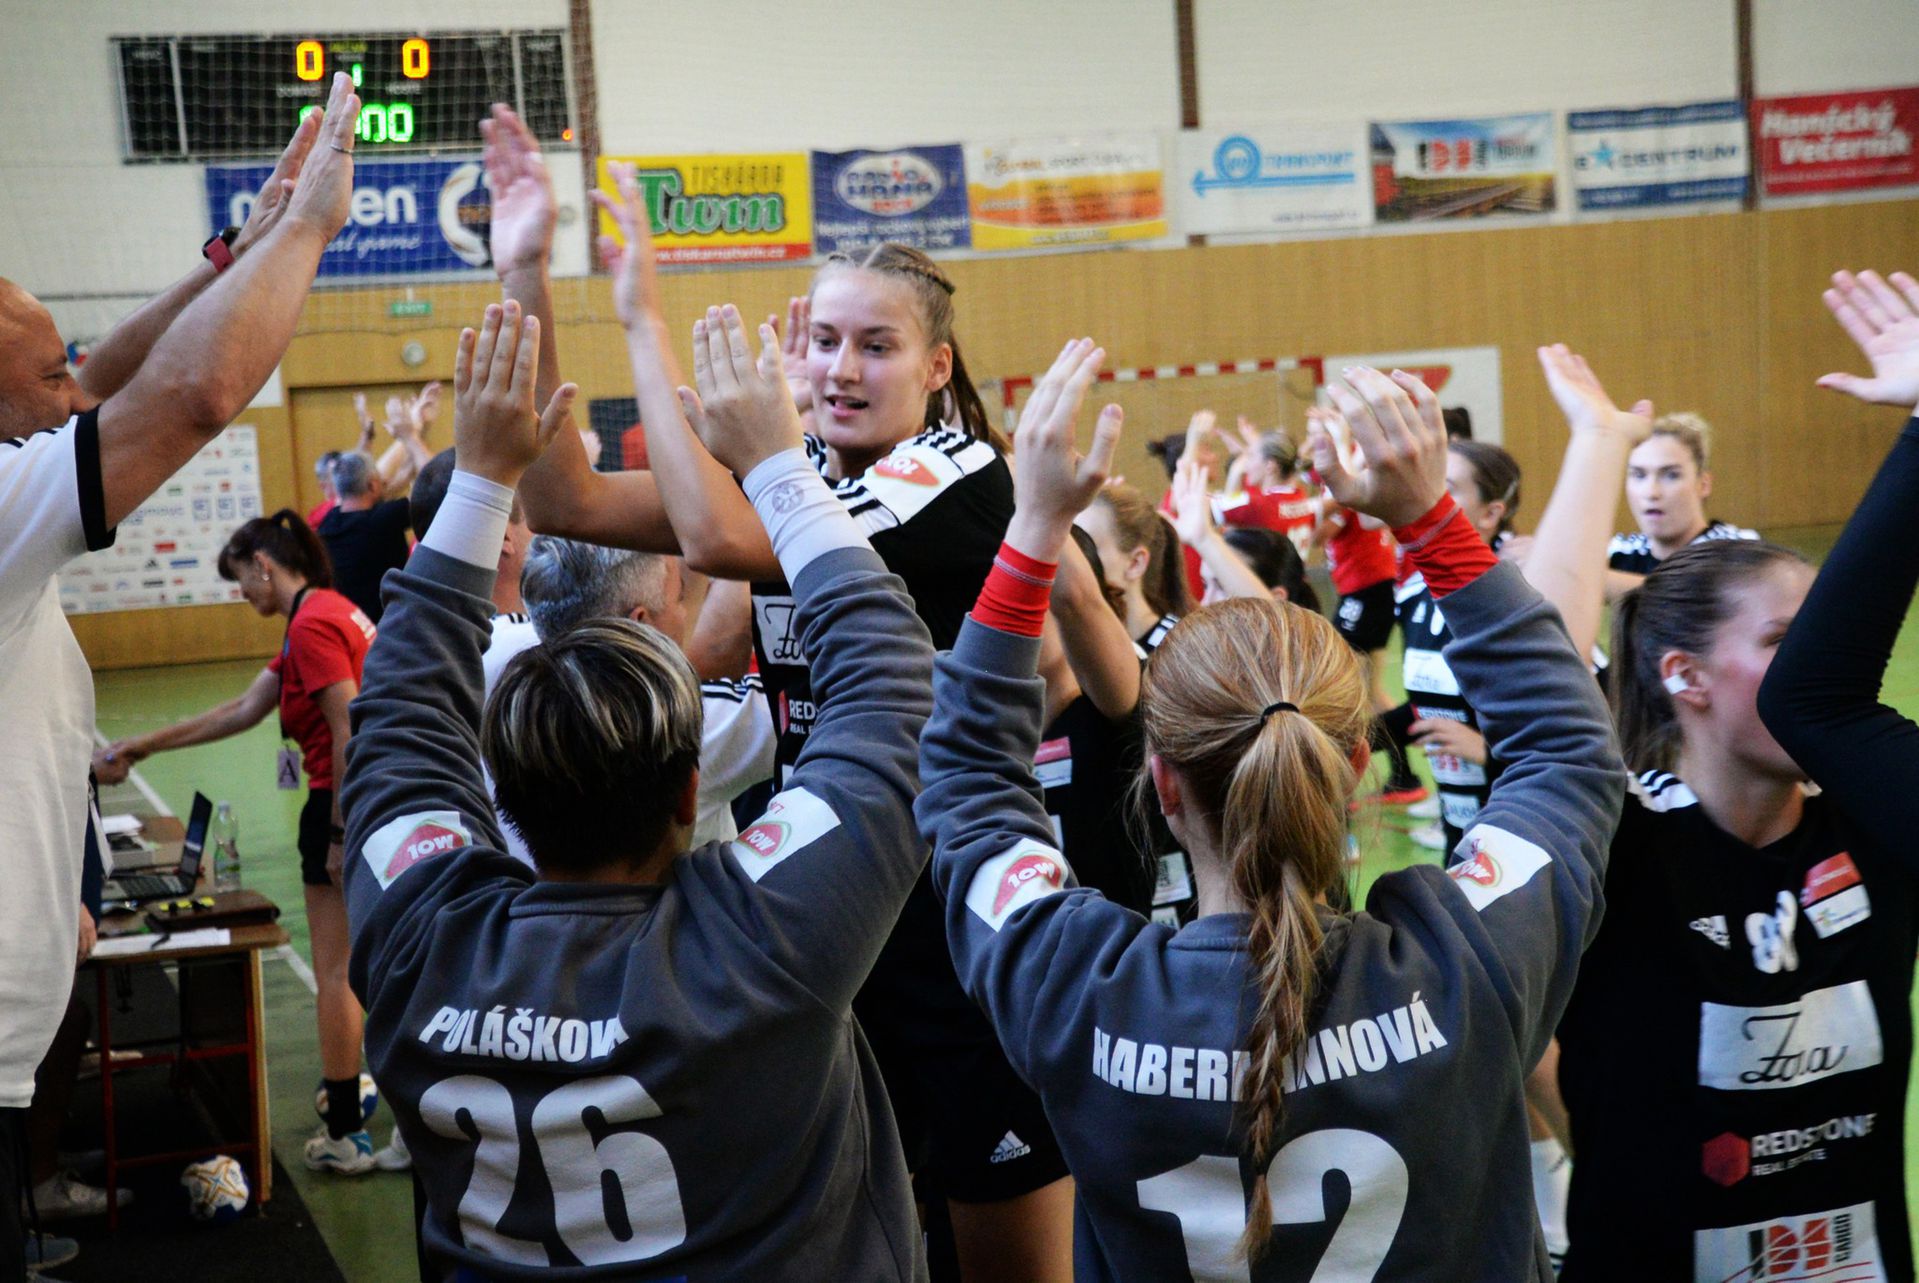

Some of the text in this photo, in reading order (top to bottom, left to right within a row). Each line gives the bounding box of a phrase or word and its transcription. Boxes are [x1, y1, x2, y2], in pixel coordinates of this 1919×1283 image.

[296, 41, 324, 80] 0
[402, 38, 430, 78] 0
[637, 168, 787, 235] Twin
[418, 1074, 688, 1268] 26
[1136, 1128, 1410, 1283] 12
